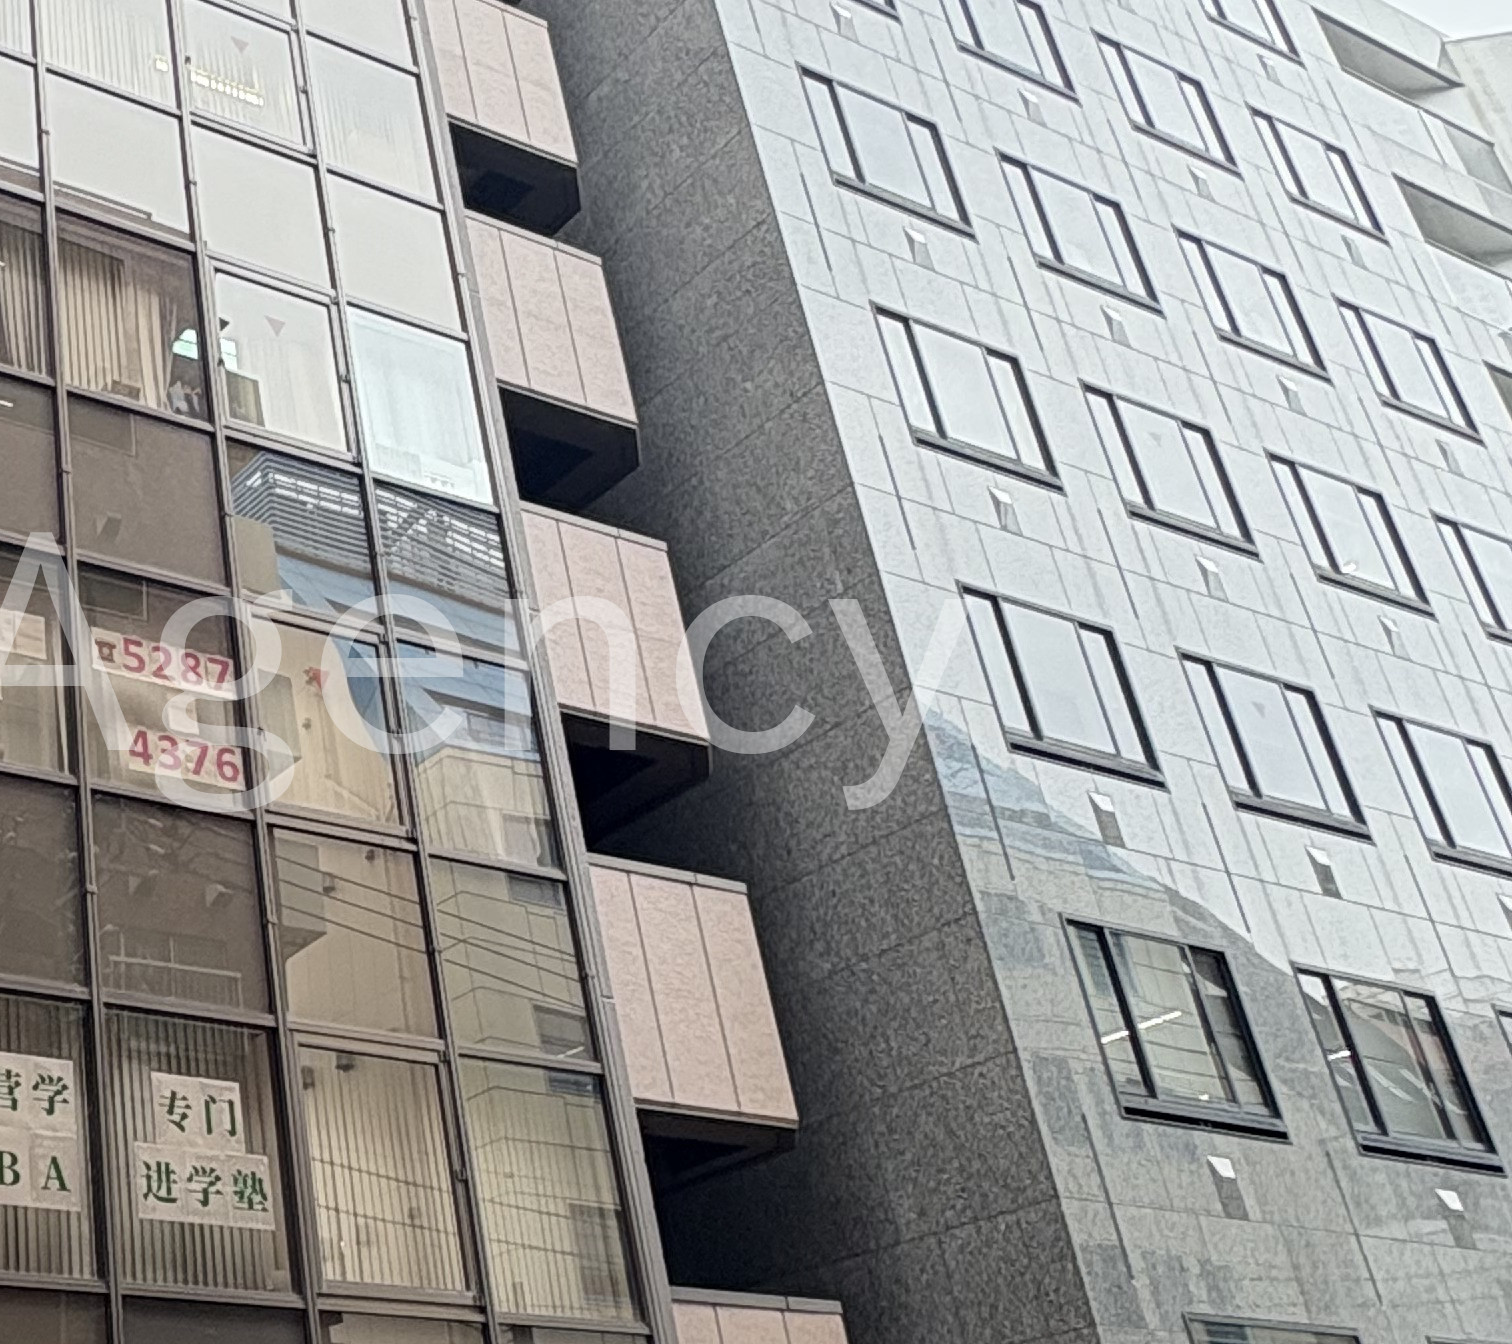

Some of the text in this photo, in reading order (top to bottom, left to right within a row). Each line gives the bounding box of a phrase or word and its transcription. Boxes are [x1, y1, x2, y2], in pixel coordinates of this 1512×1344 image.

[121, 636, 231, 692] 5287
[129, 728, 240, 783] 4376
[158, 1089, 238, 1138] 专门
[141, 1159, 270, 1214] 进学塾
